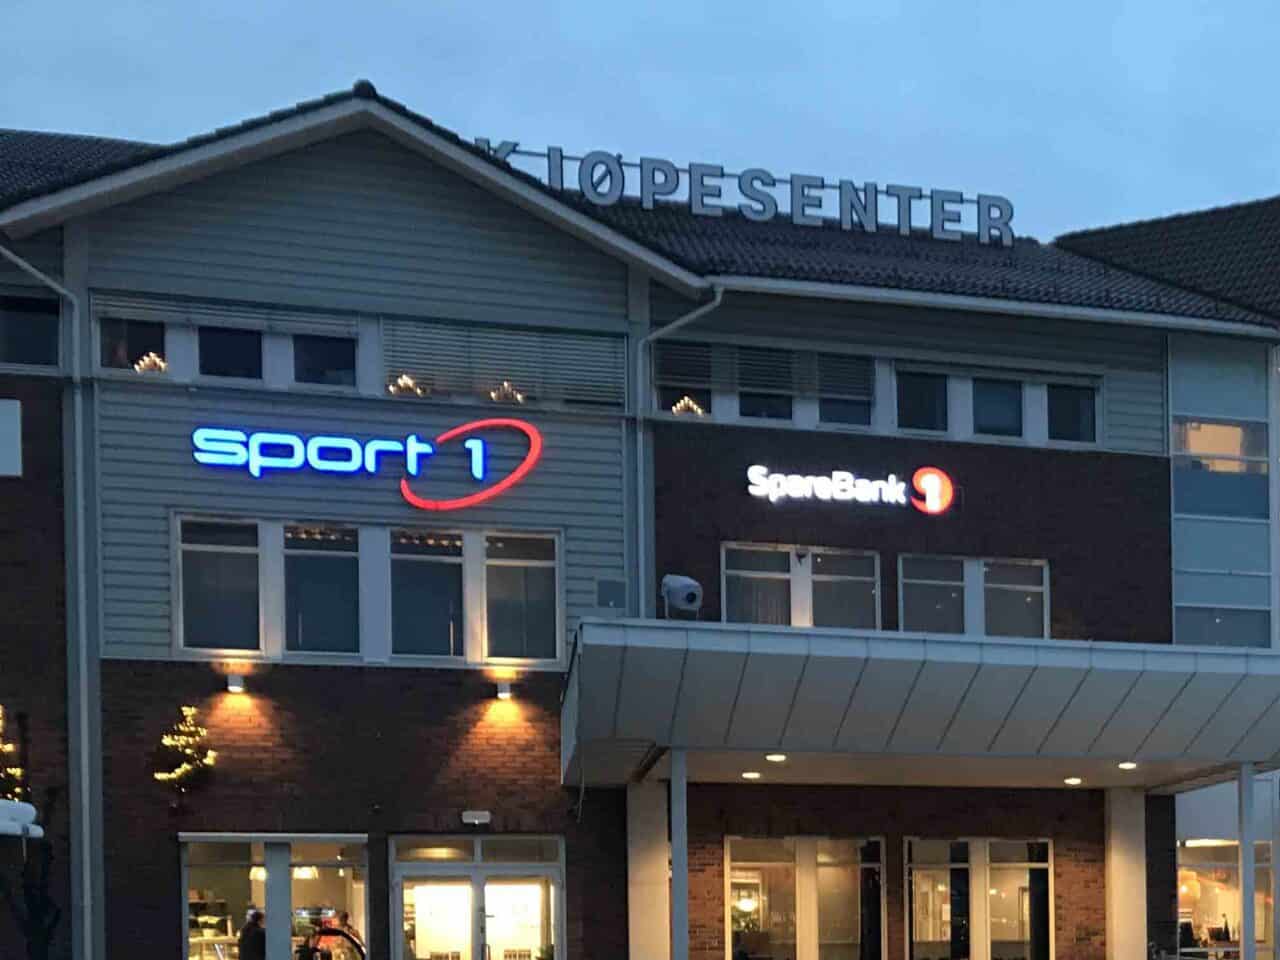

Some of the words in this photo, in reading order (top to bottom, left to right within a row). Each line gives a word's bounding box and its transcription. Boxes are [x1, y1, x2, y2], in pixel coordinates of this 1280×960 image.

[192, 427, 433, 478] sport
[464, 438, 486, 481] 1
[747, 464, 907, 504] SpareBank
